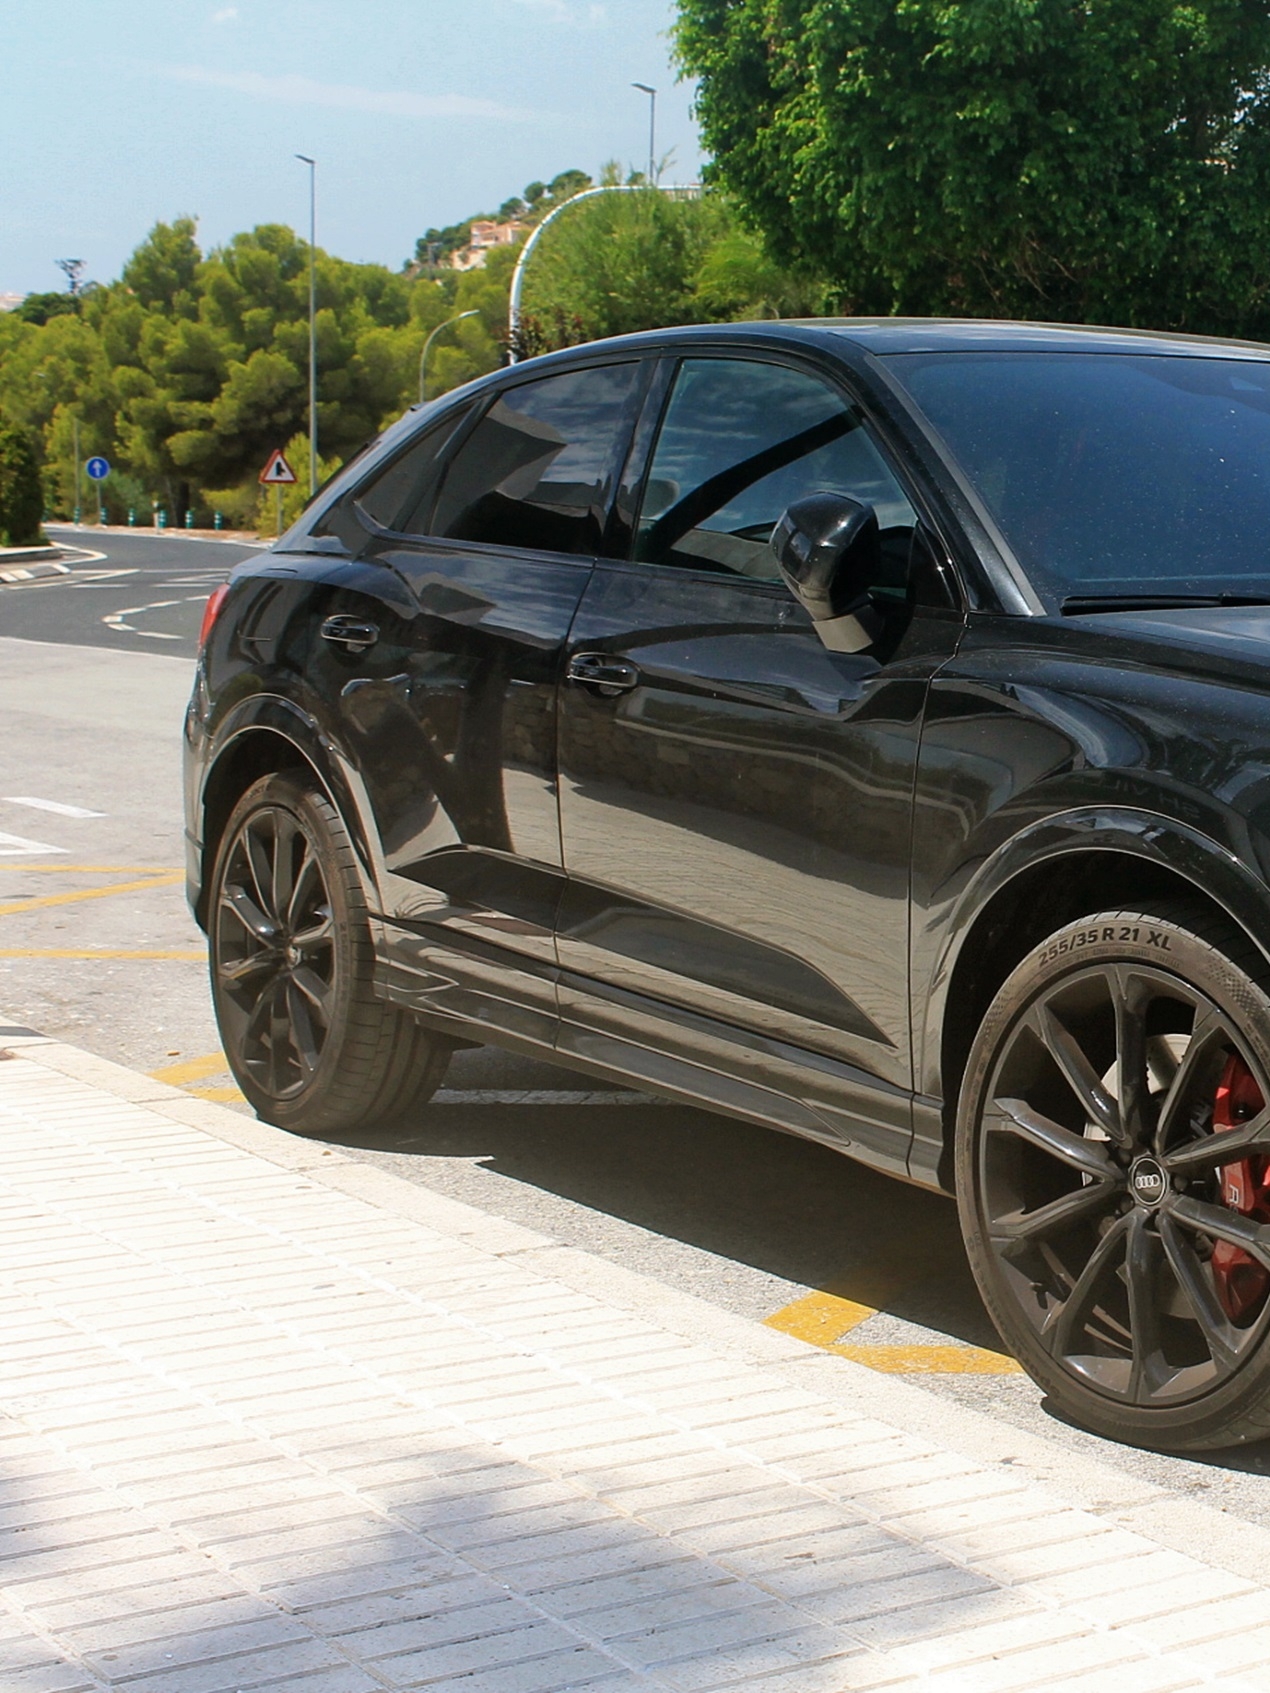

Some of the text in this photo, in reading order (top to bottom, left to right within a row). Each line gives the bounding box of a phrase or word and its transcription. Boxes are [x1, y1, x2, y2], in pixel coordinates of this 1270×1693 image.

[1038, 929, 1099, 967] 255/35
[1102, 927, 1115, 941] R
[1118, 926, 1140, 941] 21
[1146, 930, 1172, 952] XL
